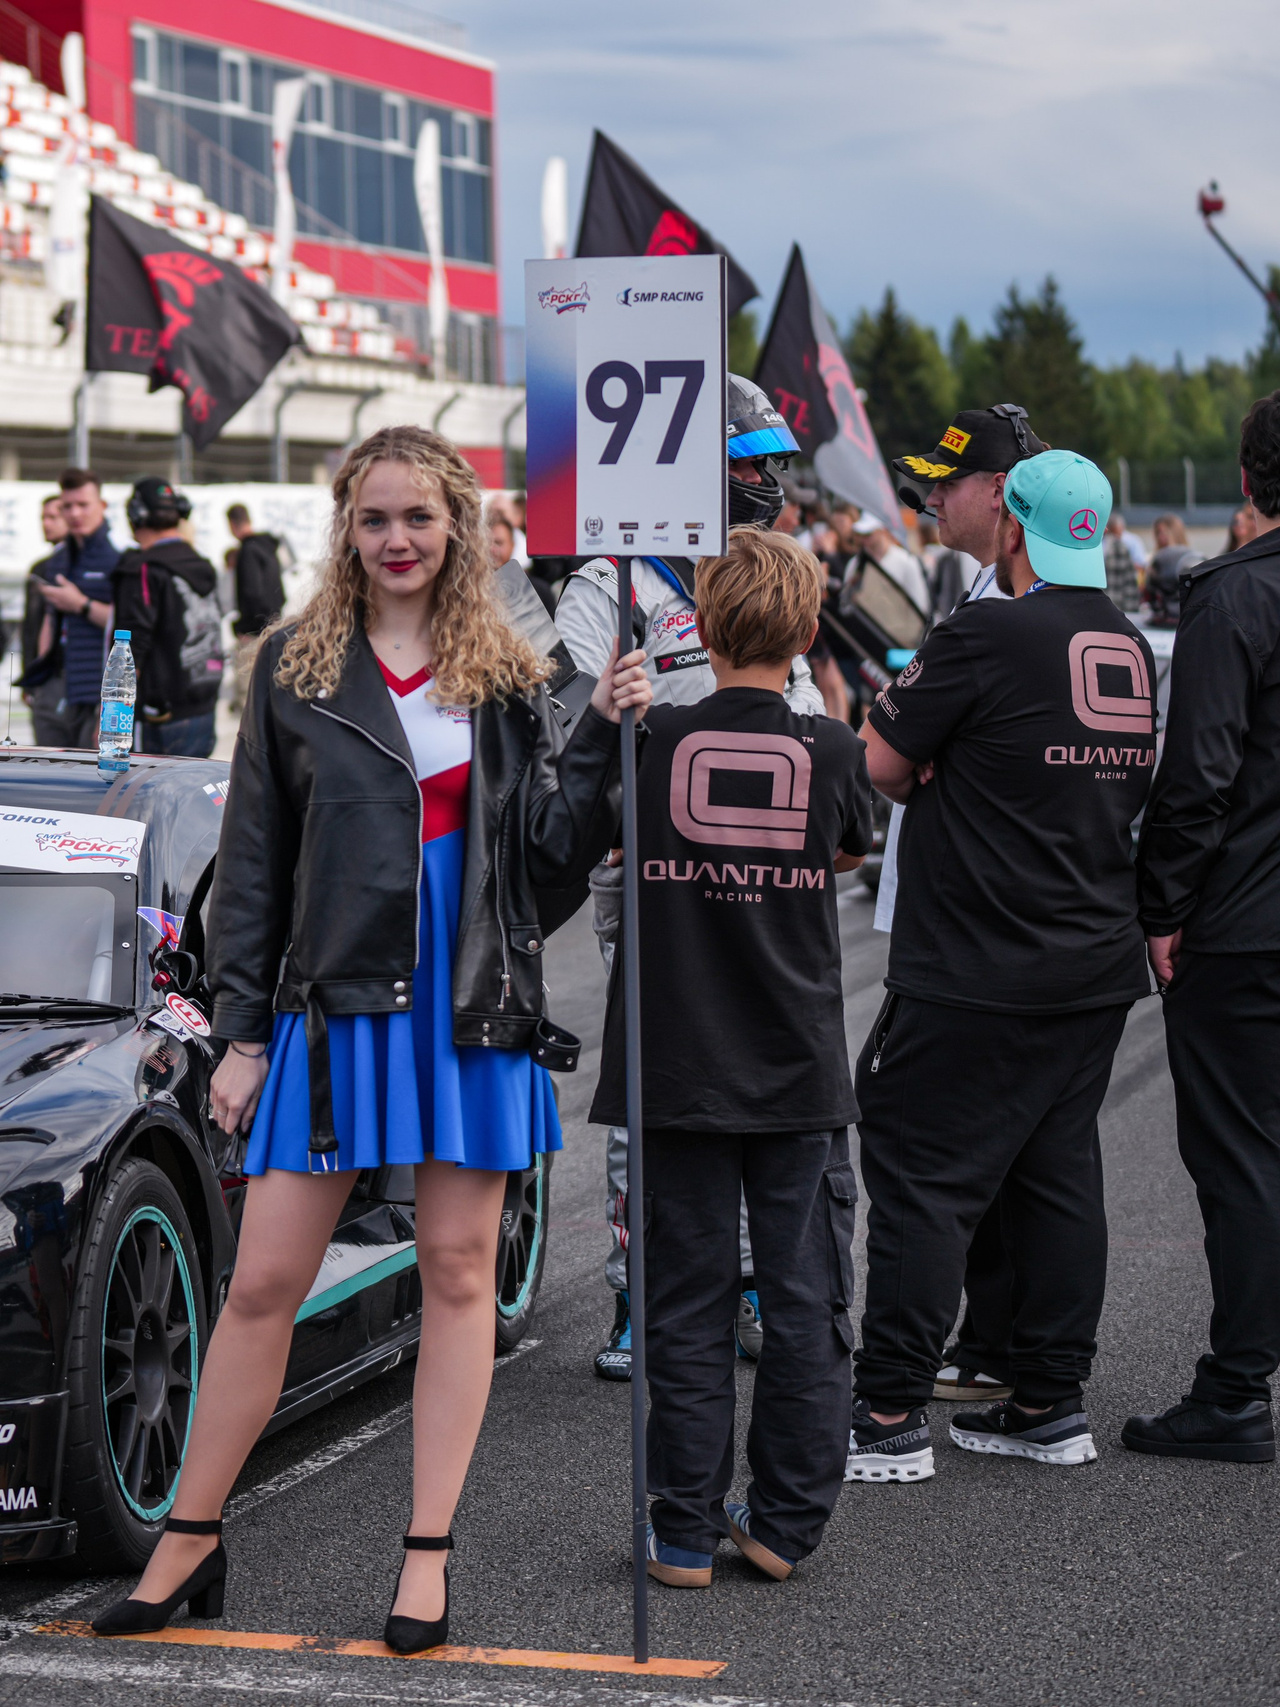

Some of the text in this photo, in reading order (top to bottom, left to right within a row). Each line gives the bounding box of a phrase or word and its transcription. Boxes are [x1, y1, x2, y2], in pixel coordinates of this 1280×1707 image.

[550, 293, 582, 303] РСКГ
[633, 291, 704, 302] SMP RACING
[586, 360, 705, 465] 97
[666, 613, 694, 629] РСК
[674, 651, 709, 665] YOKOHA
[1095, 771, 1128, 780] RACING
[56, 839, 122, 853] РСКГ
[643, 859, 826, 890] QUANTUM
[704, 890, 763, 903] RACING
